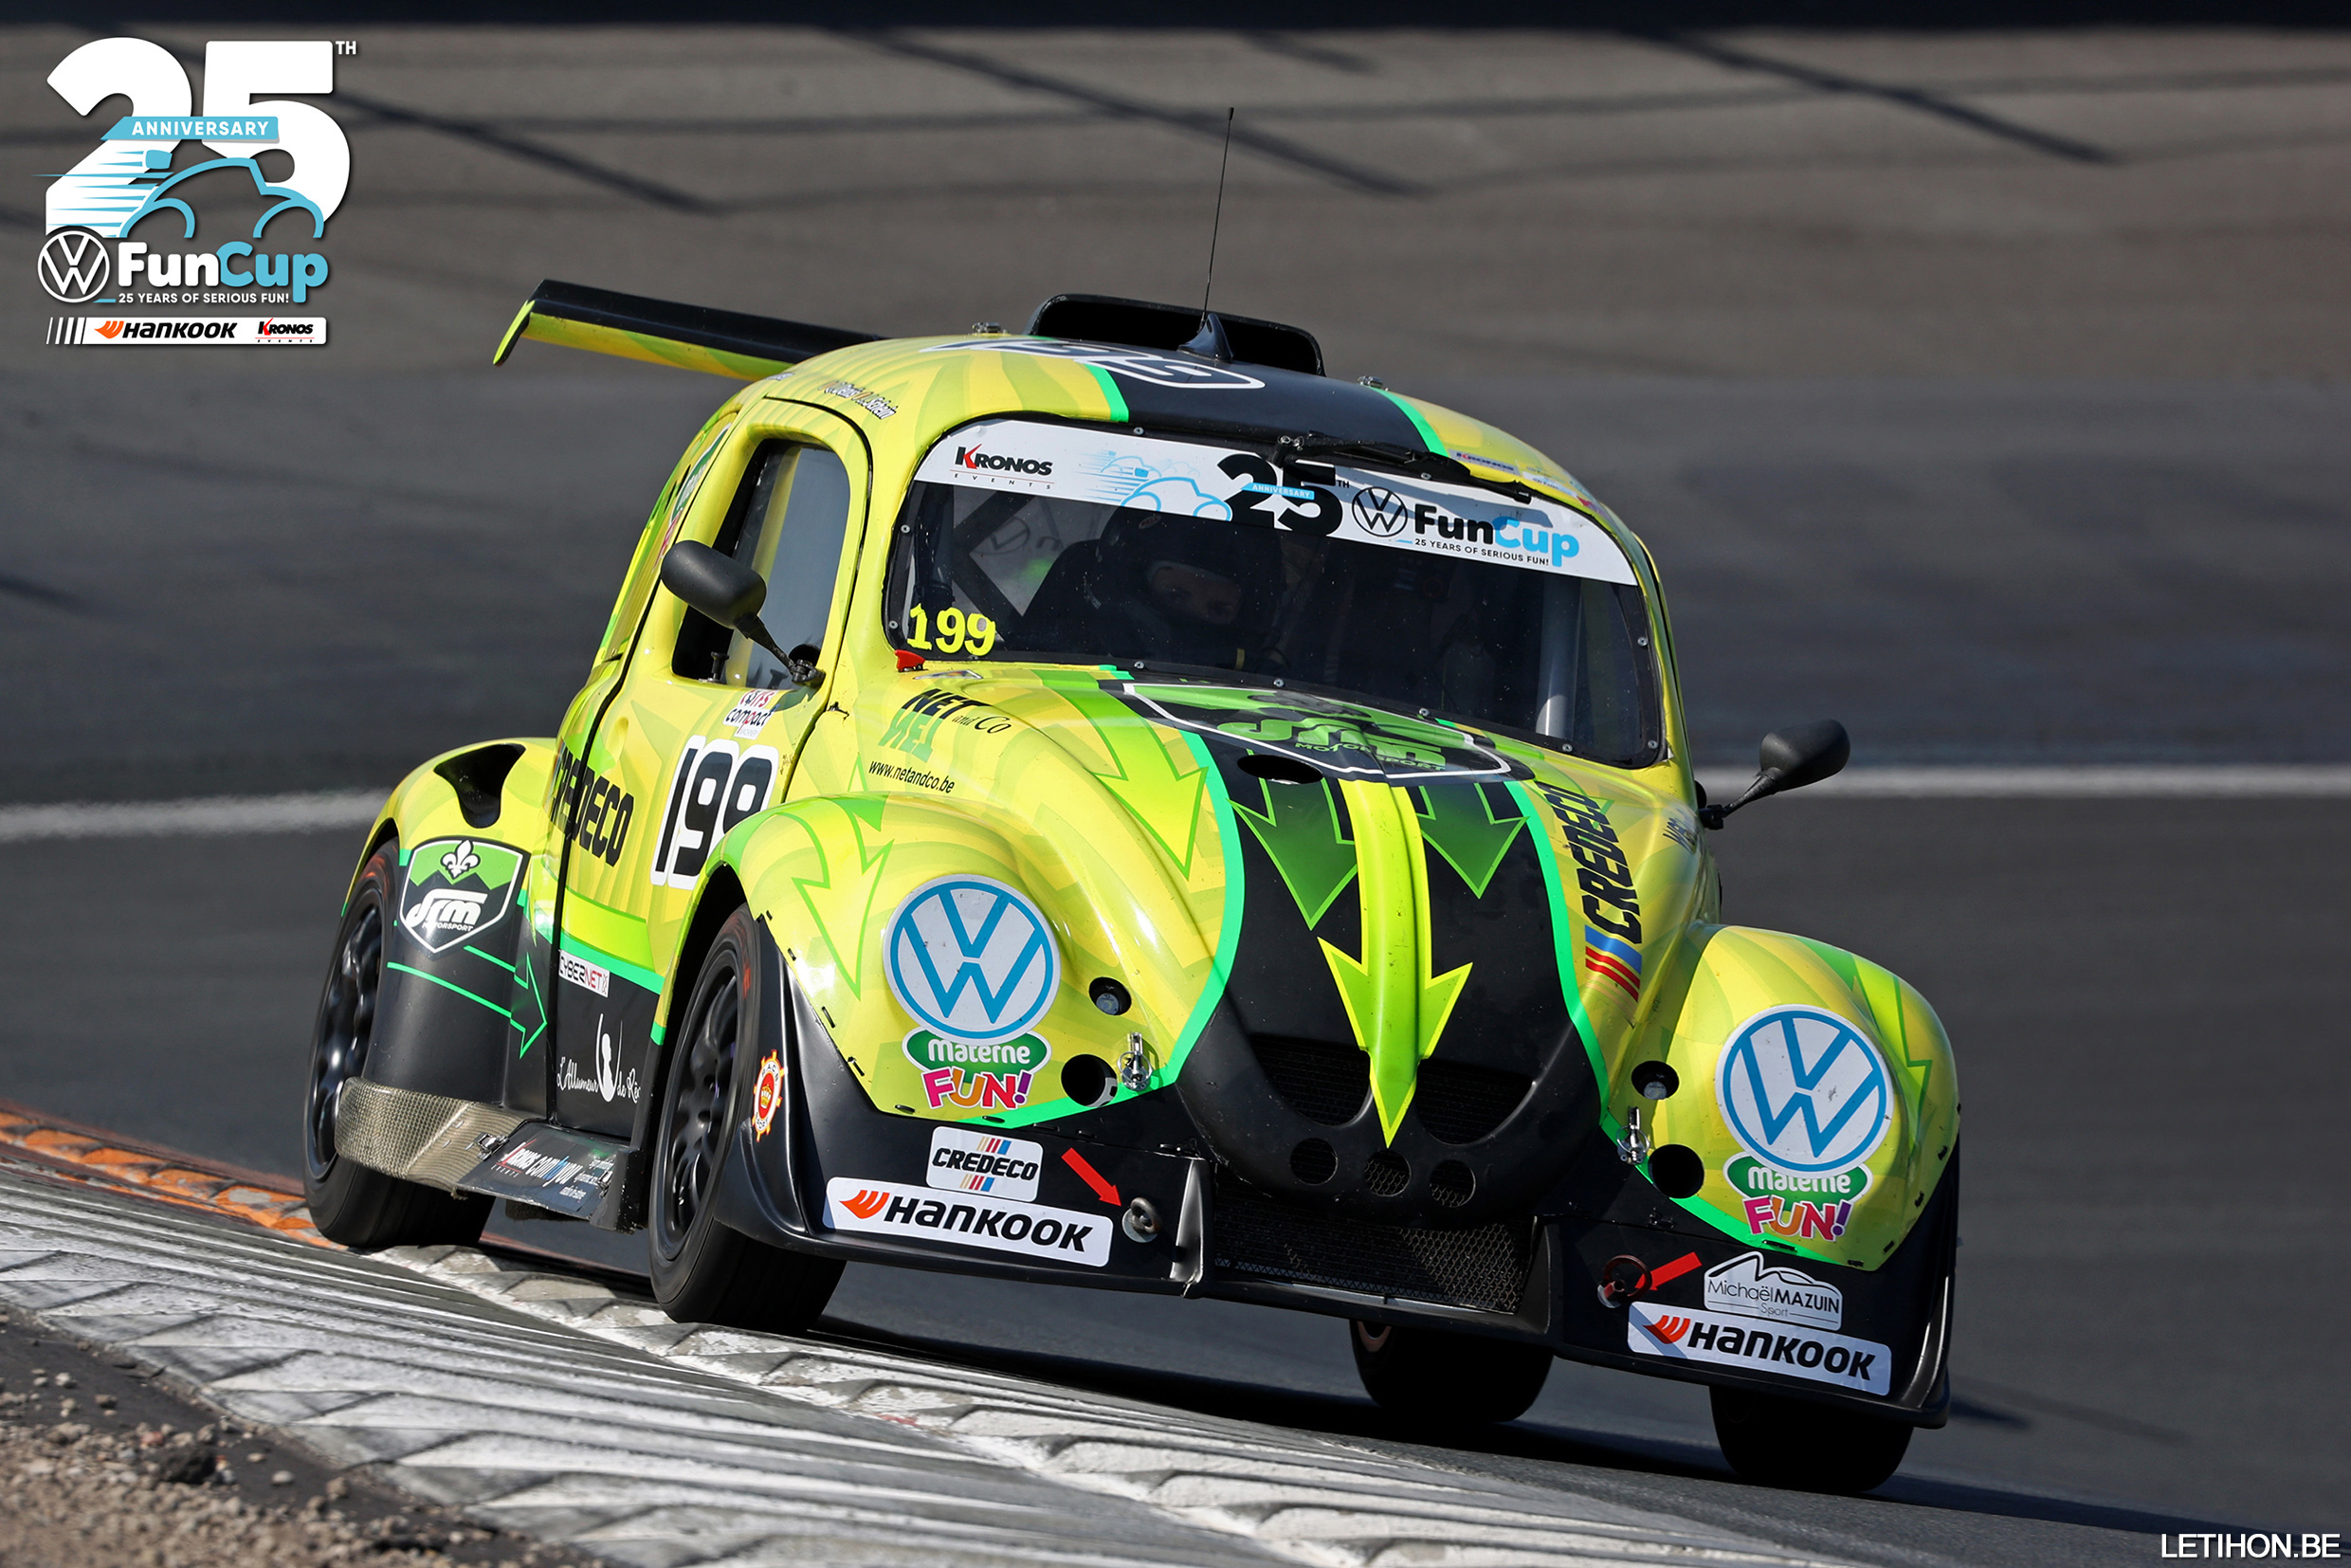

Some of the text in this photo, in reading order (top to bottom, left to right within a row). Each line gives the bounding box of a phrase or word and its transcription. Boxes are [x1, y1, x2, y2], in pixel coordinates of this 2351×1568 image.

[955, 443, 1053, 476] KRONOS
[1251, 483, 1311, 498] ANNIVERSARY
[1336, 479, 1350, 489] TH
[1414, 504, 1580, 567] FunCup
[1414, 538, 1550, 566] 25 YEARS OF SERIOUS FUN!
[906, 603, 995, 656] 199
[975, 716, 1011, 734] Co
[868, 760, 955, 793] www.netandco.be
[652, 745, 775, 880] 199
[1537, 780, 1642, 944] CREDECO
[921, 1066, 1034, 1109] FUN!
[932, 1147, 1039, 1181] CREDECO
[1742, 1194, 1853, 1242] FUN!
[1707, 1280, 1840, 1315] Michaël MAZUIN
[1760, 1303, 1789, 1318] Sport
